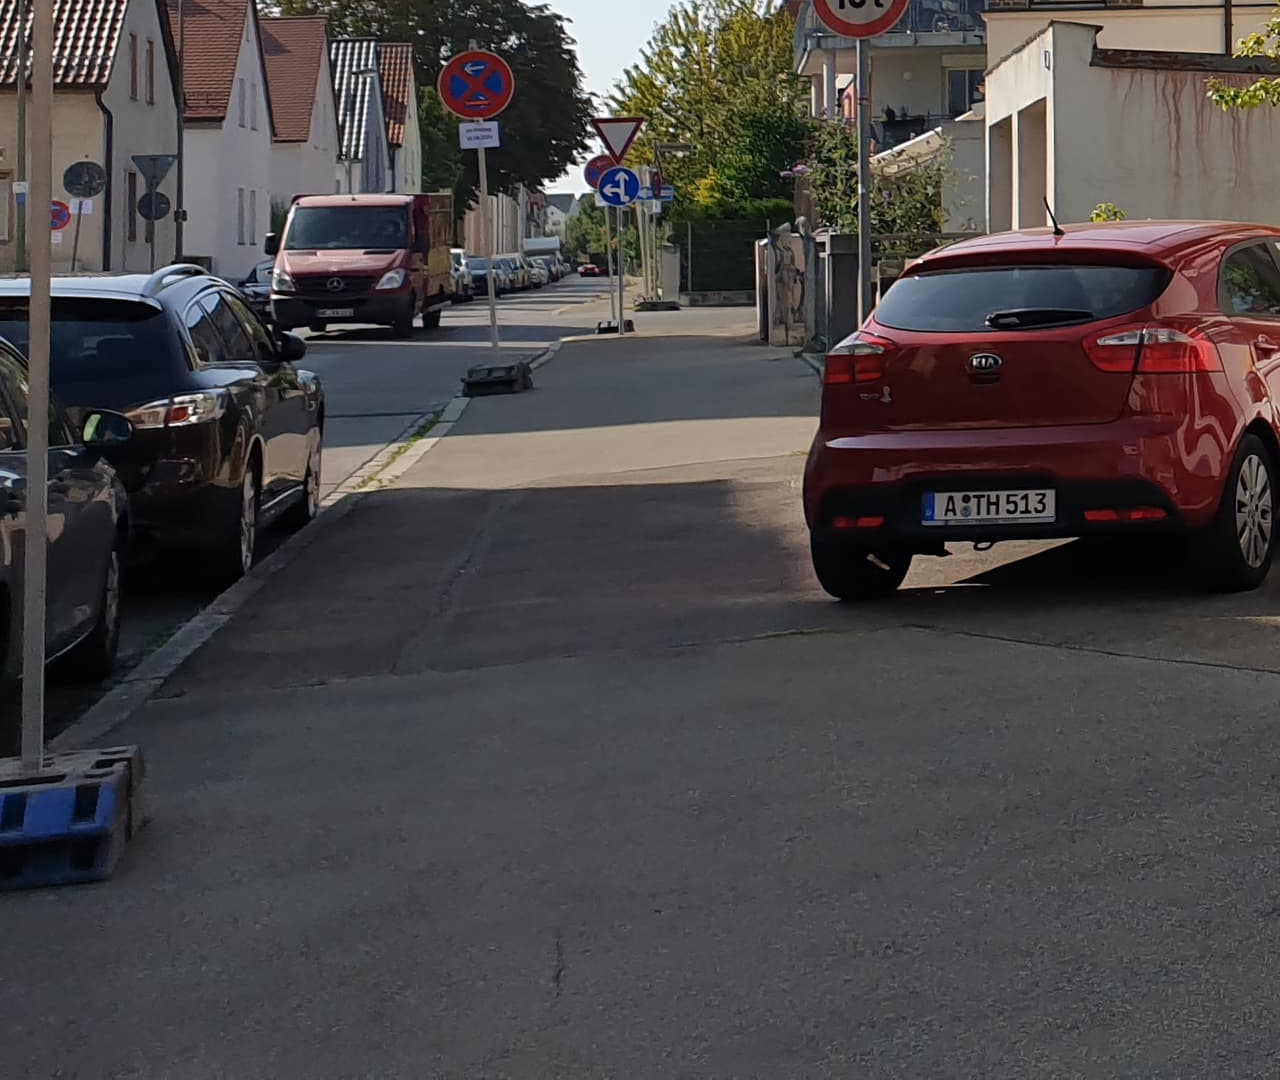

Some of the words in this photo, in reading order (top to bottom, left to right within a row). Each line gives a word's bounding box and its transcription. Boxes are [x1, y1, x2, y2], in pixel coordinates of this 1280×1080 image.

[972, 357, 996, 368] KIA
[943, 495, 957, 517] A
[972, 494, 1000, 516] TH
[1005, 493, 1047, 514] 513
